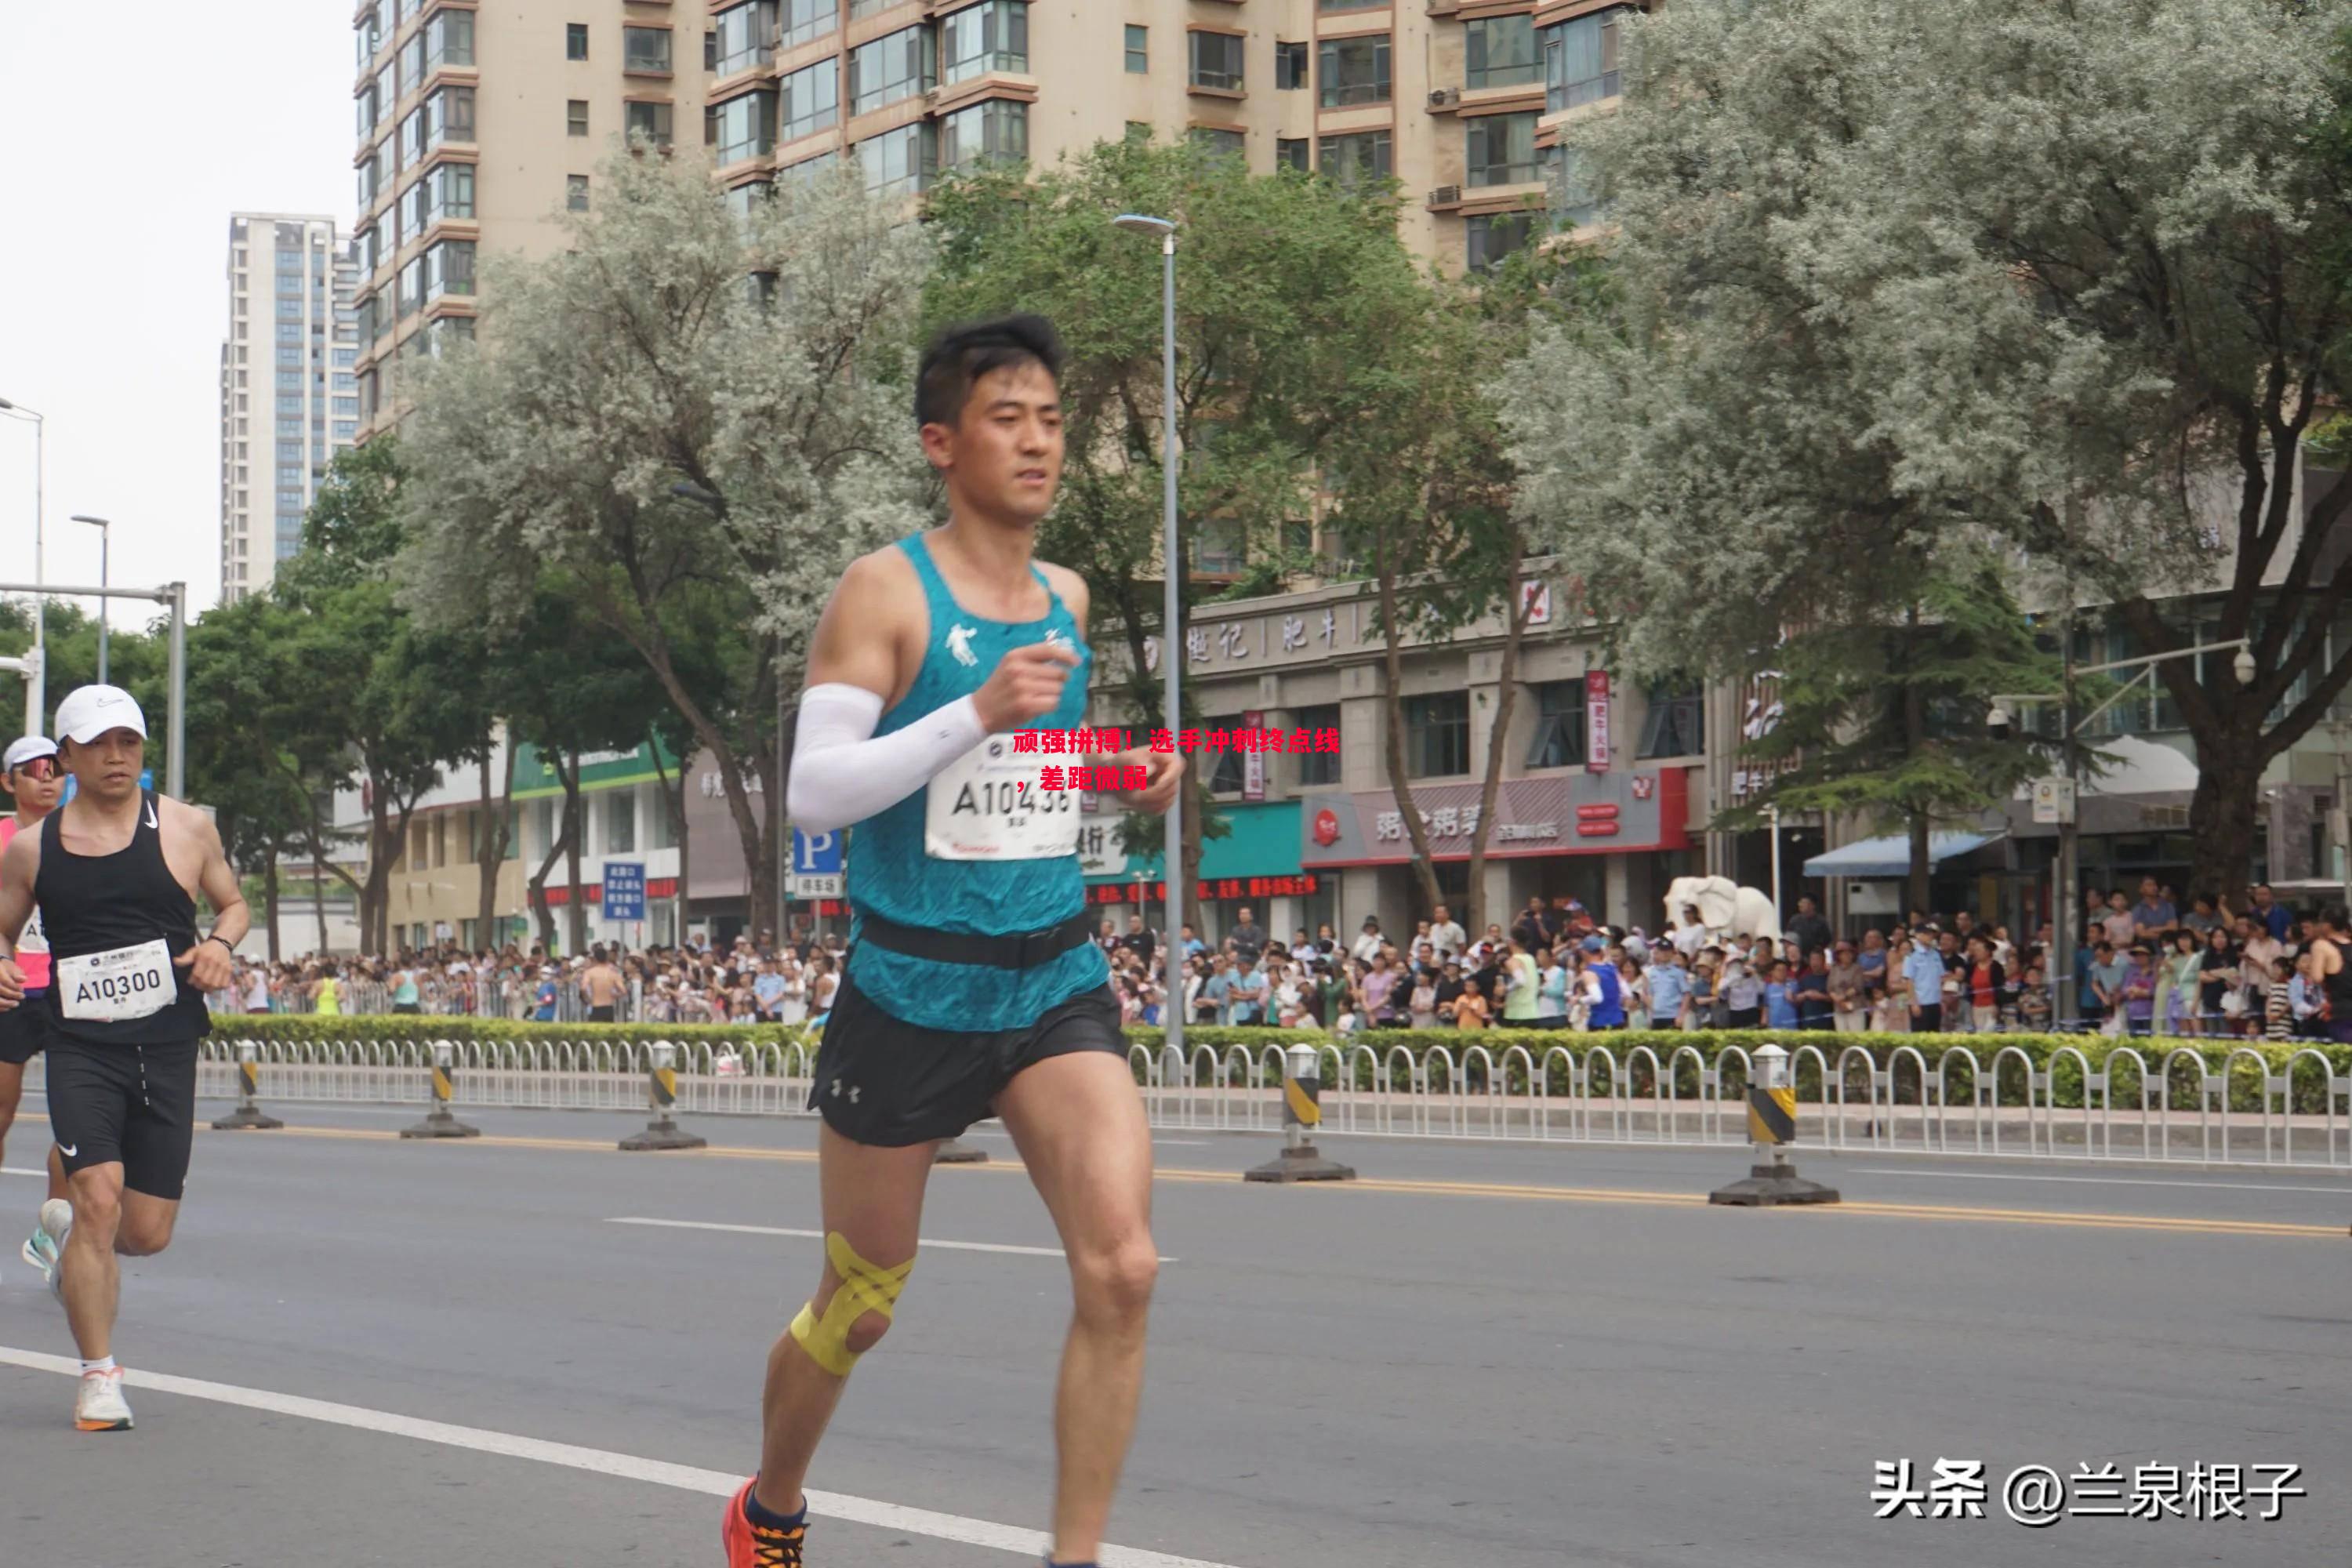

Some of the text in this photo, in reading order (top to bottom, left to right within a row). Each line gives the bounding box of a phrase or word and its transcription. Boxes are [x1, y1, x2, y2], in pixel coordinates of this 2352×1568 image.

[800, 832, 832, 869] P
[802, 879, 834, 893] 停车场
[77, 969, 160, 1003] A10300
